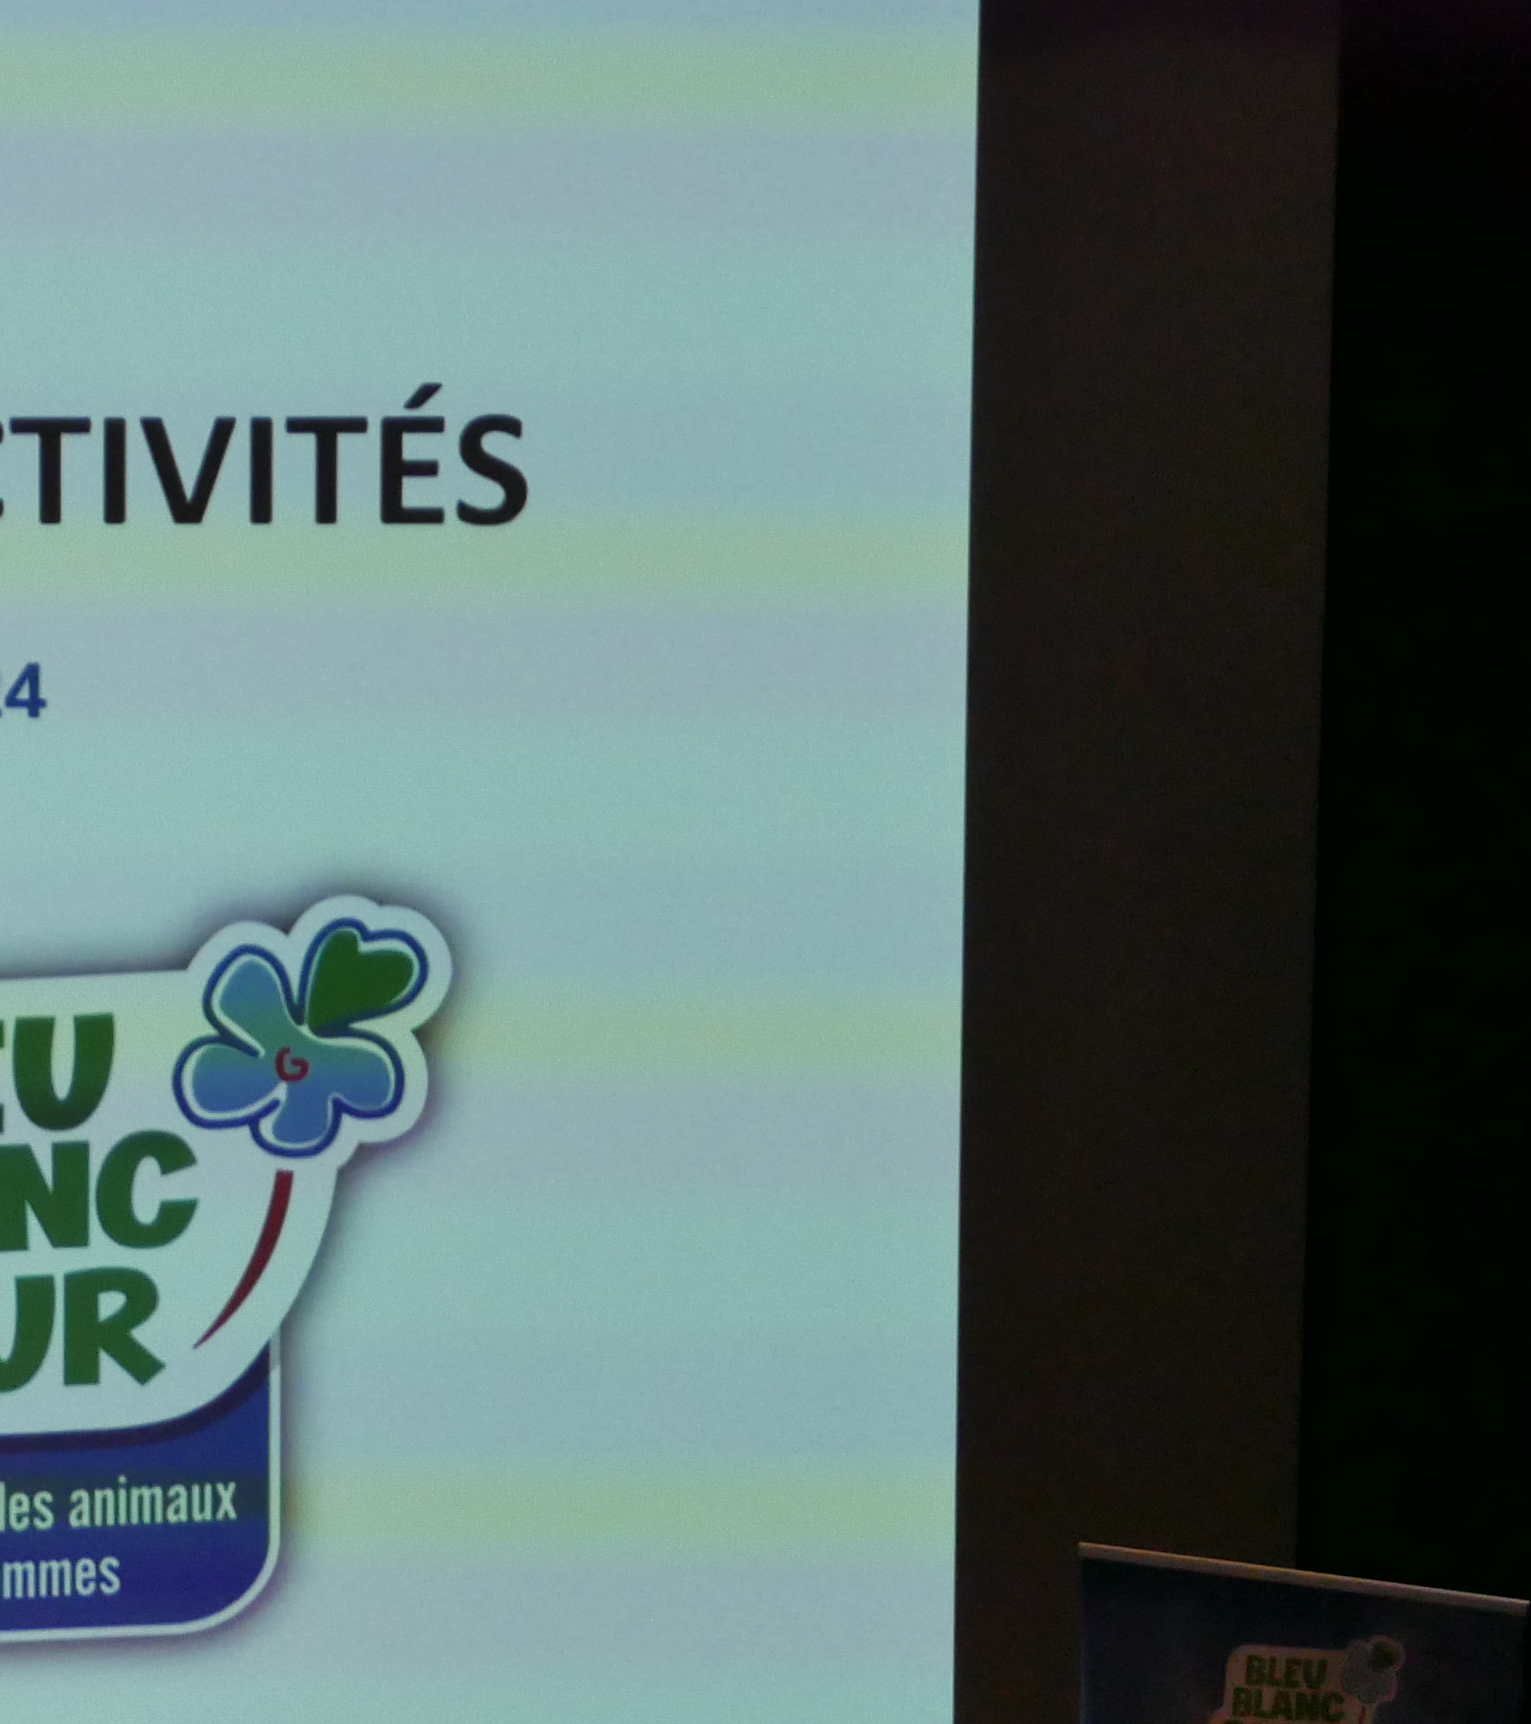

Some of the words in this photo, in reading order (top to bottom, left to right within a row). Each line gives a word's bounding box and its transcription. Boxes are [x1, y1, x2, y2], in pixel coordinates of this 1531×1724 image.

[69, 1479, 237, 1529] animaux
[1245, 1654, 1327, 1690] BLEU
[1232, 1686, 1345, 1723] BLANC
